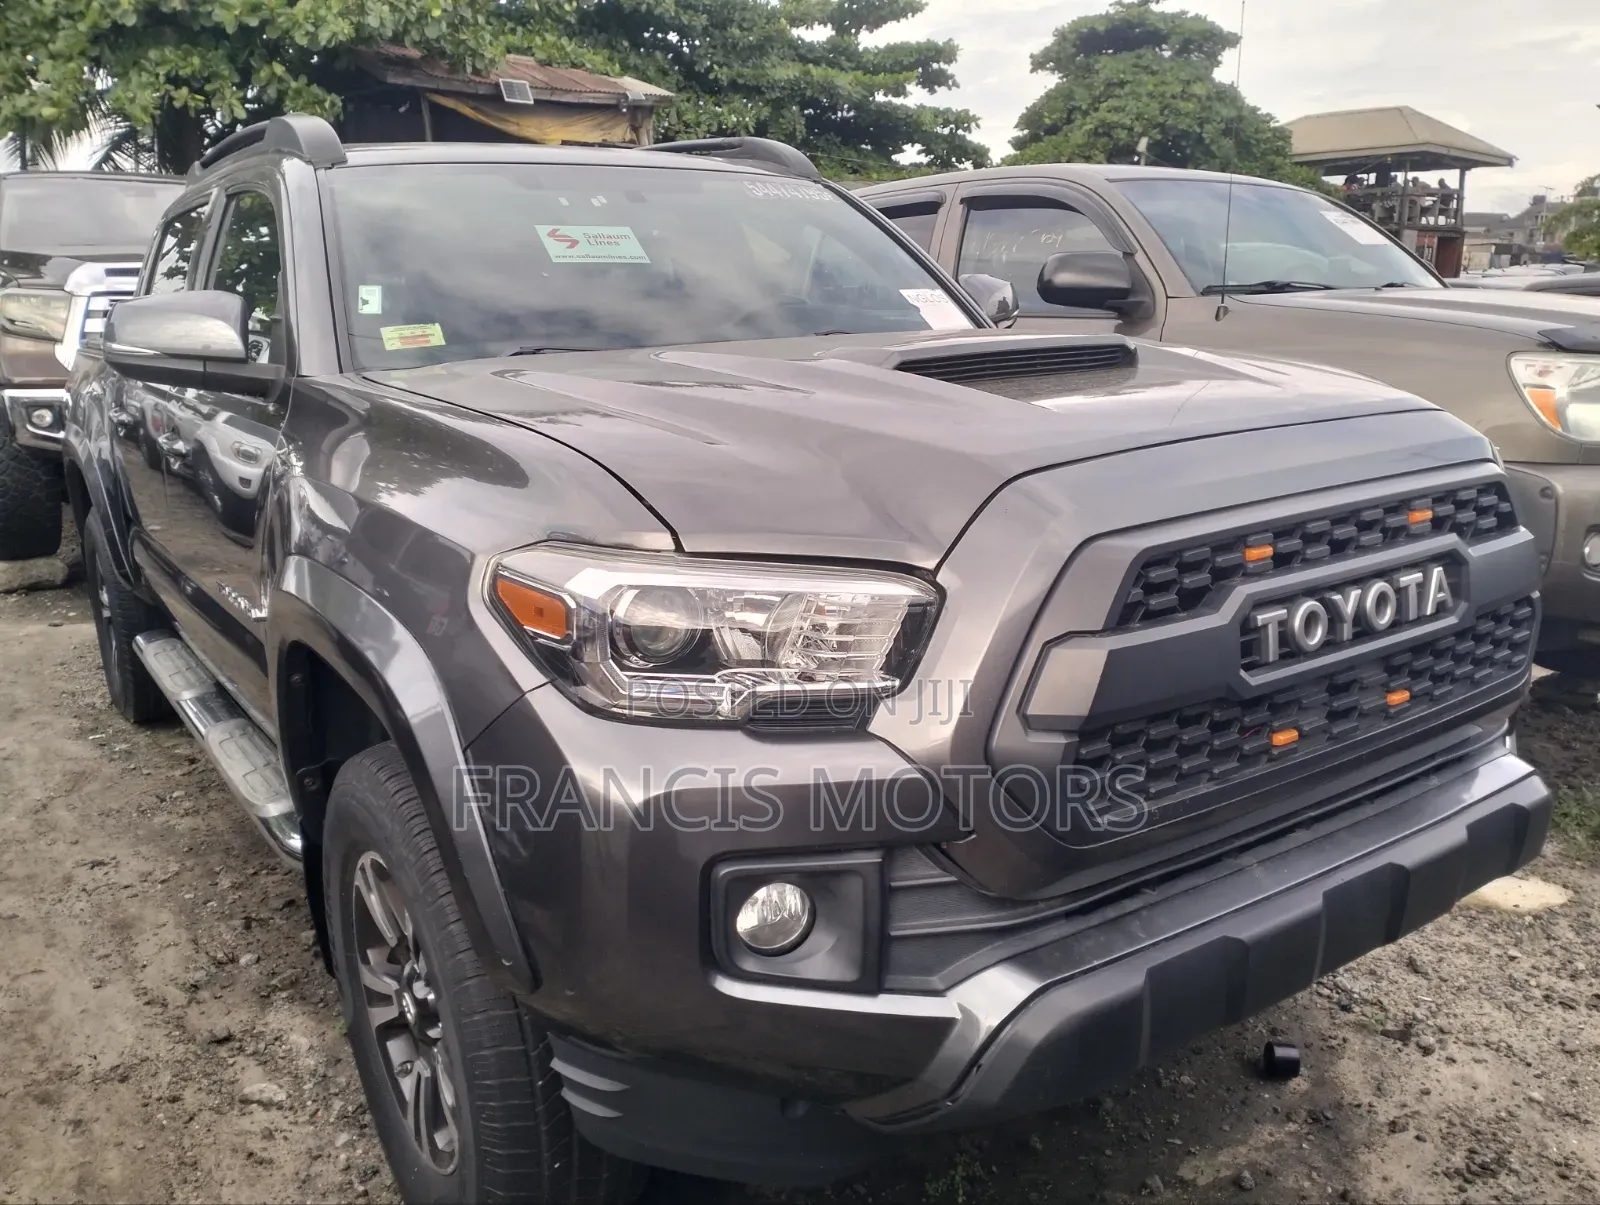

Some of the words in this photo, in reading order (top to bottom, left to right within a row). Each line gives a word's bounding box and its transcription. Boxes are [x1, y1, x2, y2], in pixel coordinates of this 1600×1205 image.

[583, 232, 631, 240] Sallaum
[586, 239, 621, 247] Lines
[1255, 566, 1453, 663] TOYOTA
